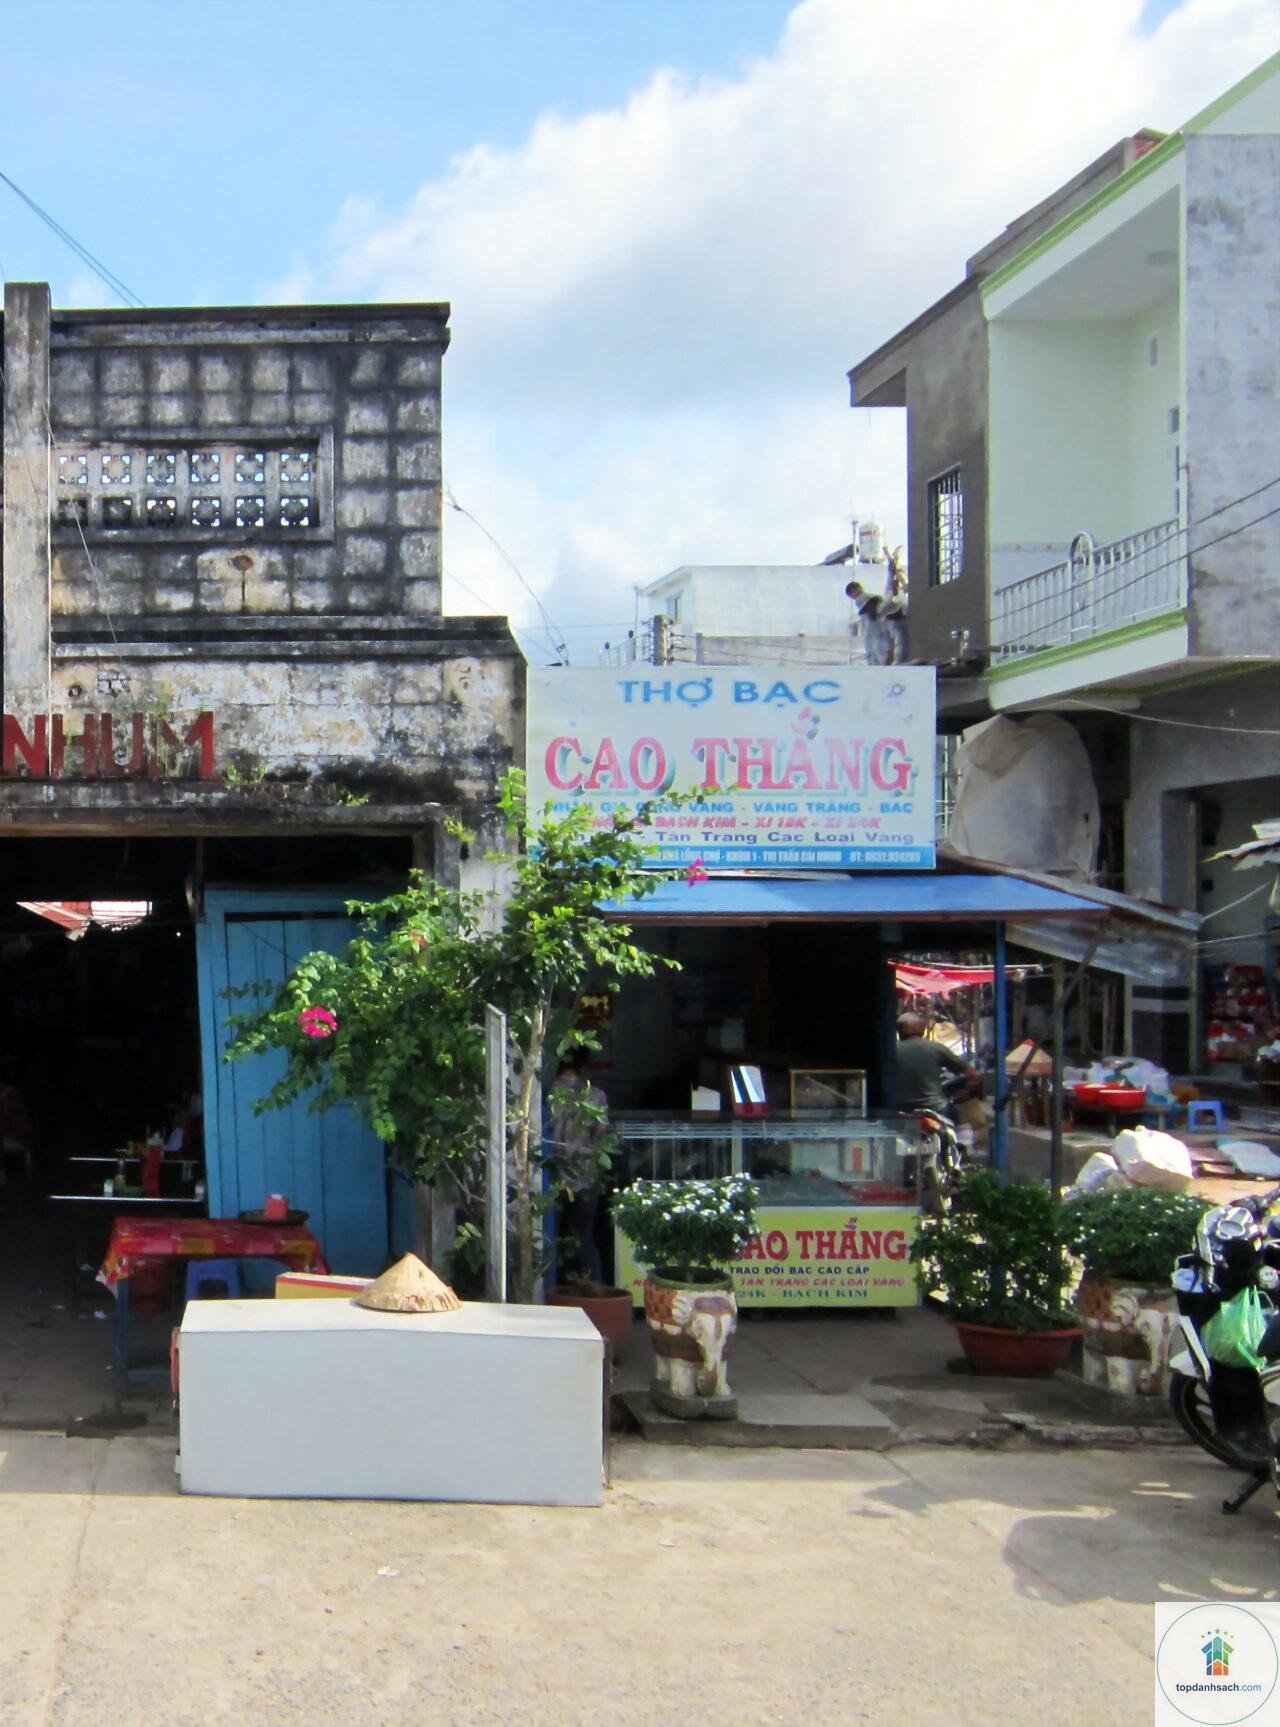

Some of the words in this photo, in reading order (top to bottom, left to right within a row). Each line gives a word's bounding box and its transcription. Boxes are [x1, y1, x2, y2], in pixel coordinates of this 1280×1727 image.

[617, 677, 713, 708] THỢ
[733, 680, 841, 708] BẠC
[2, 710, 214, 778] NHUM
[544, 735, 669, 792] CAO
[701, 831, 758, 845] Trang
[738, 1230, 789, 1262] AO
